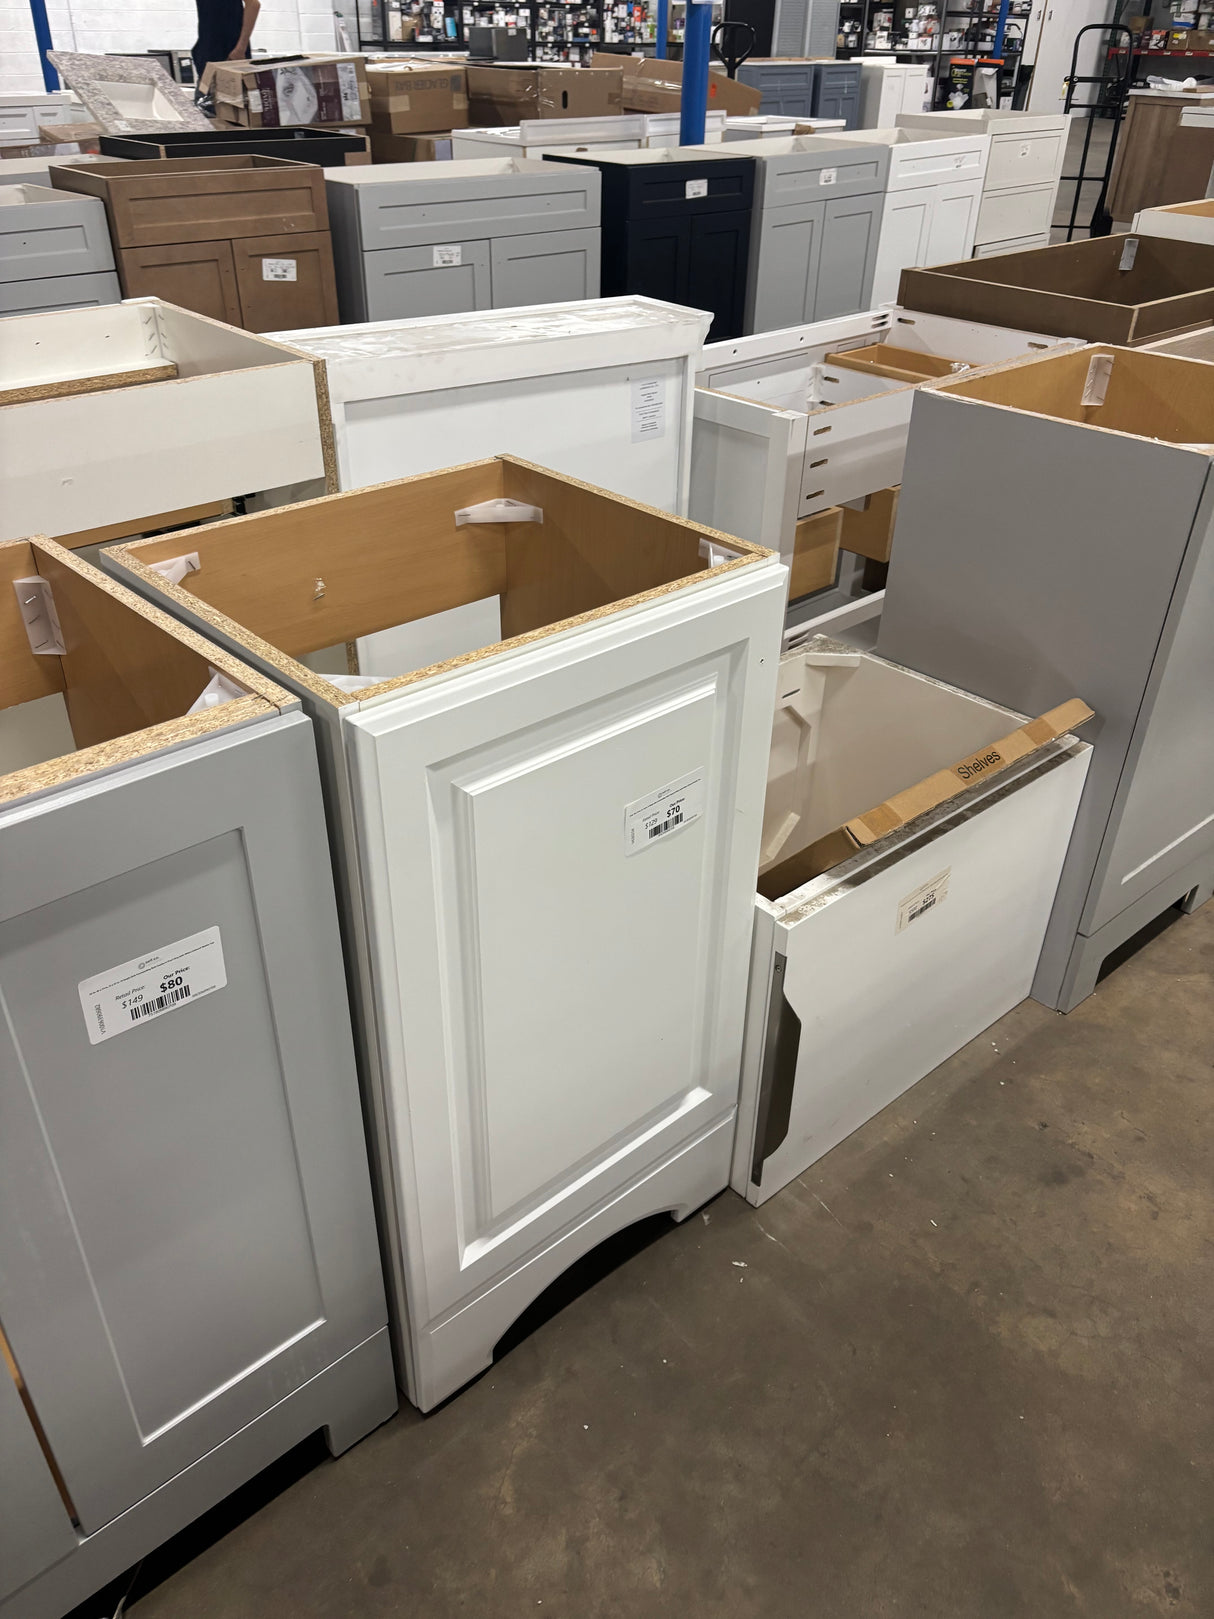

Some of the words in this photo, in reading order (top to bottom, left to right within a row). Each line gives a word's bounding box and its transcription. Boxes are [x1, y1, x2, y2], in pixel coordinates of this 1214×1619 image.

[957, 751, 1001, 779] Shelves
[667, 805, 681, 818] $70
[163, 972, 174, 980] Our
[174, 965, 191, 976] Price:
[159, 976, 184, 993] $80
[115, 989, 131, 1001] Retail
[121, 994, 144, 1010] $149
